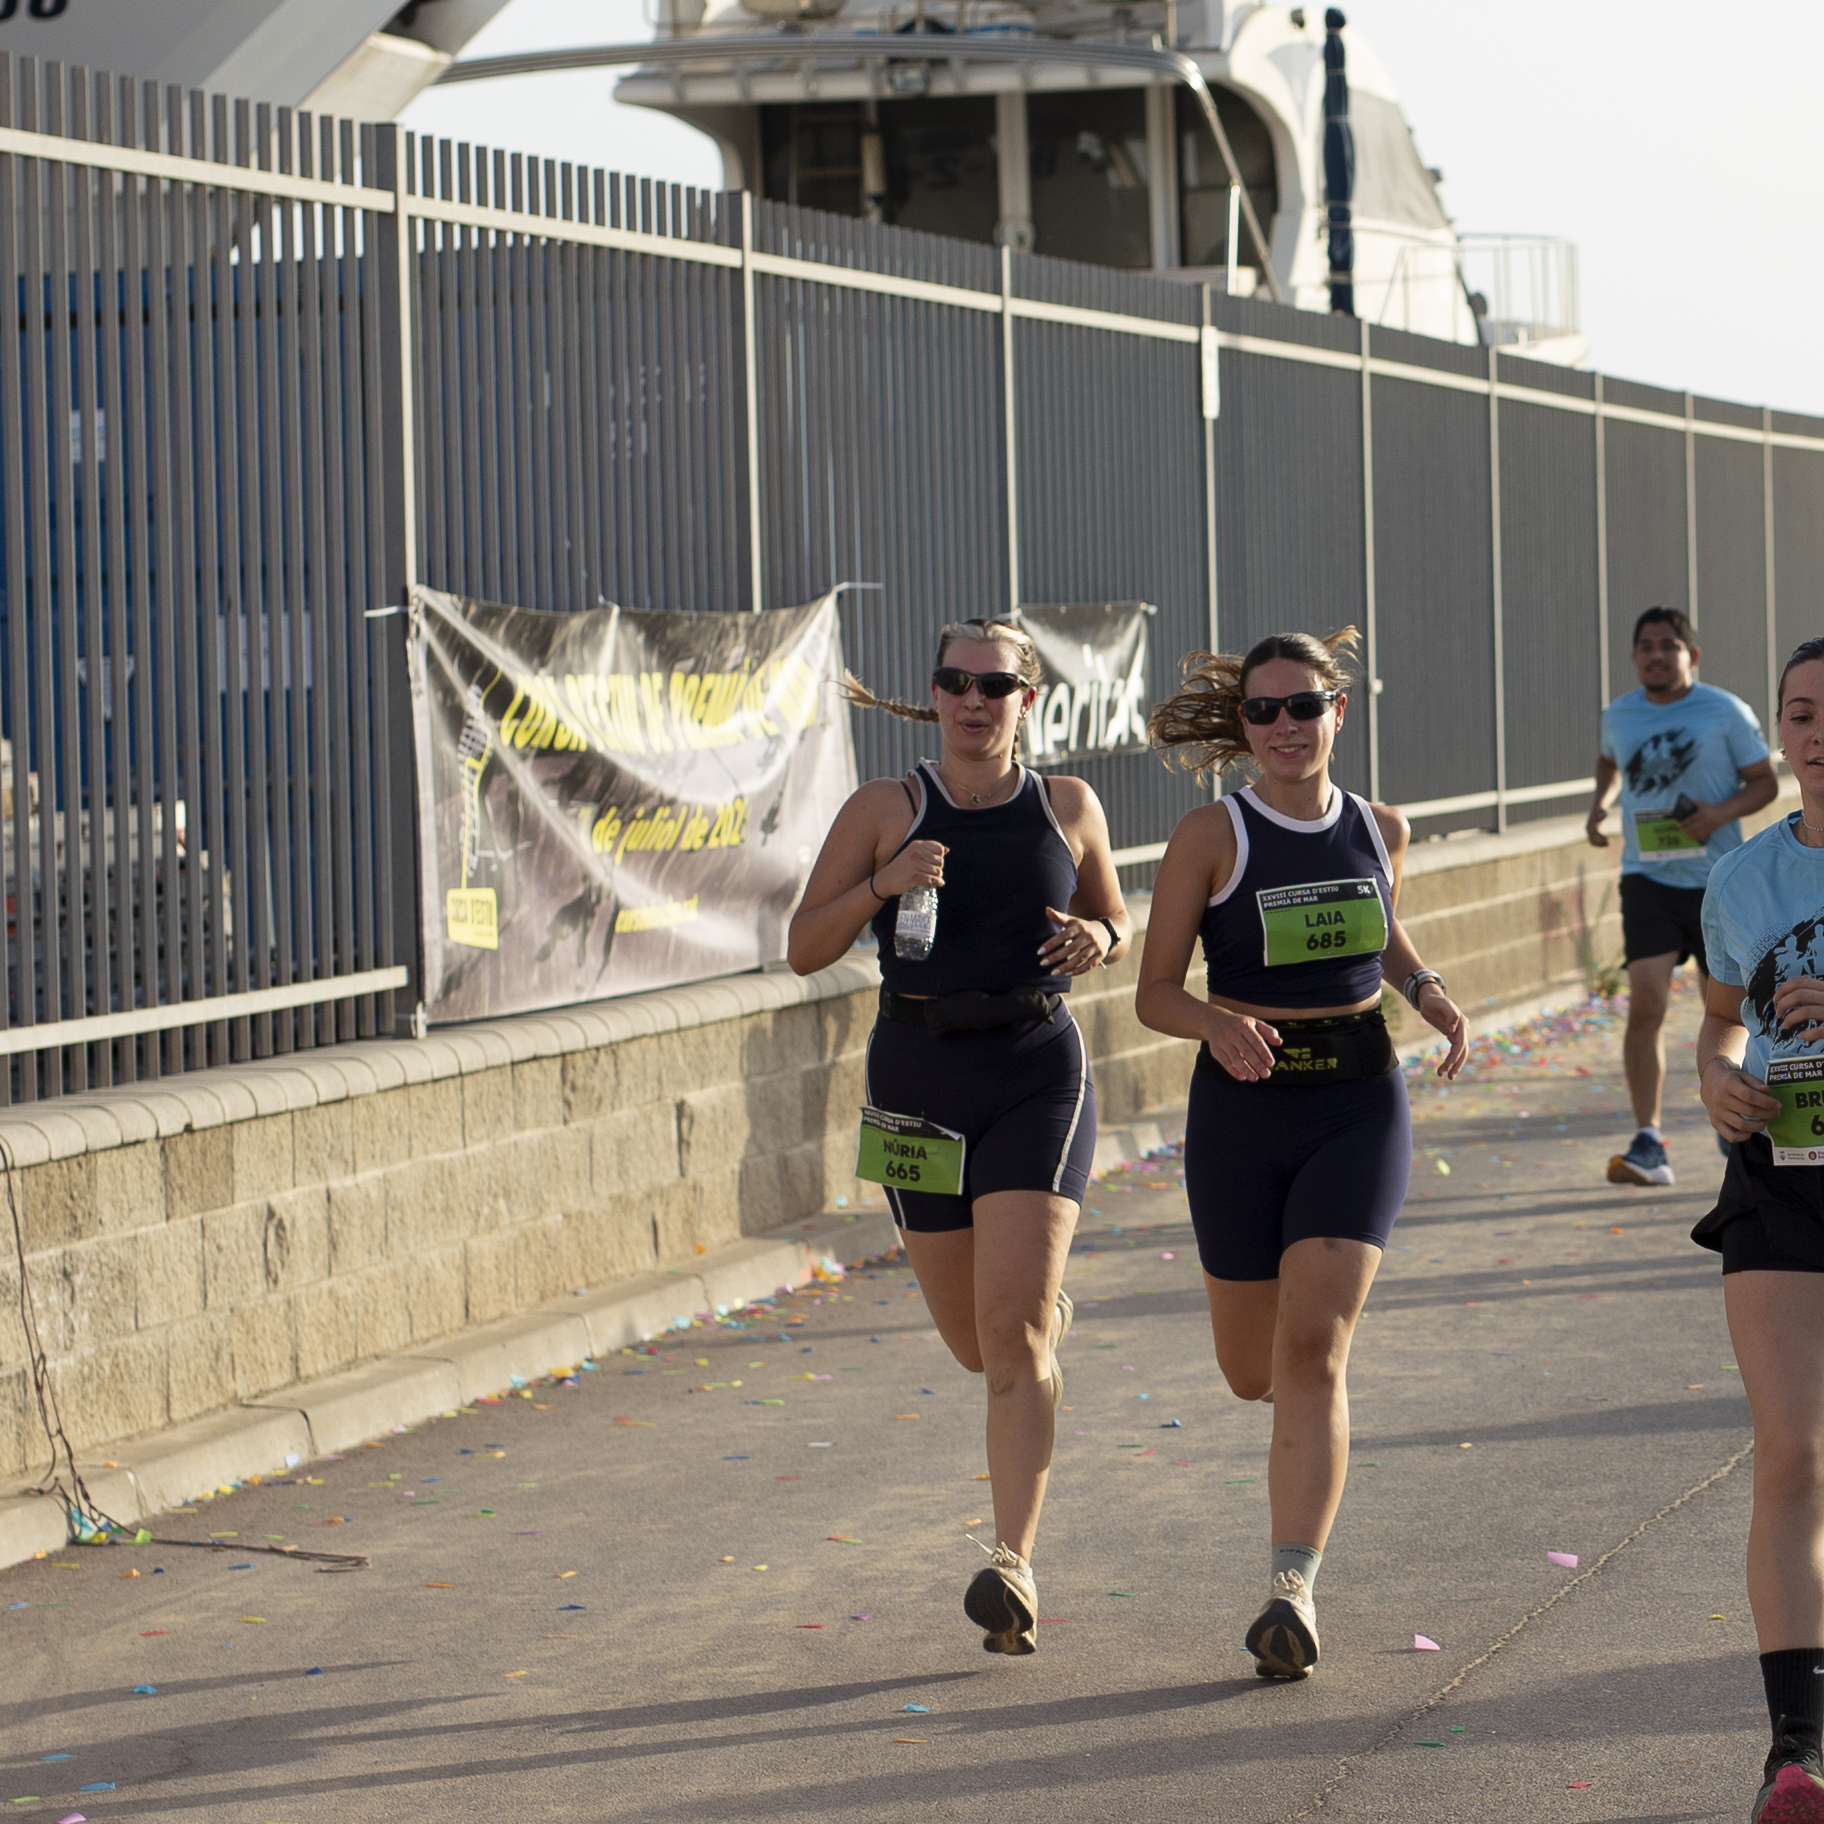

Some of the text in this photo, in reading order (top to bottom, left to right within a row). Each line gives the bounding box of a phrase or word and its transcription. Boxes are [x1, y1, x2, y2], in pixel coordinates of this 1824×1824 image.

[592, 805, 622, 855] de
[614, 805, 688, 867] juliol
[680, 803, 710, 853] de
[1287, 887, 1311, 898] CURSA
[1357, 884, 1373, 895] 5K
[1304, 910, 1346, 928] LAIA
[1306, 930, 1347, 951] 685
[1789, 1061, 1815, 1072] CURSA
[1793, 1071, 1804, 1081] DE
[1804, 1069, 1823, 1079] MAR
[883, 1138, 928, 1160] NÚRIA
[885, 1160, 921, 1183] 665
